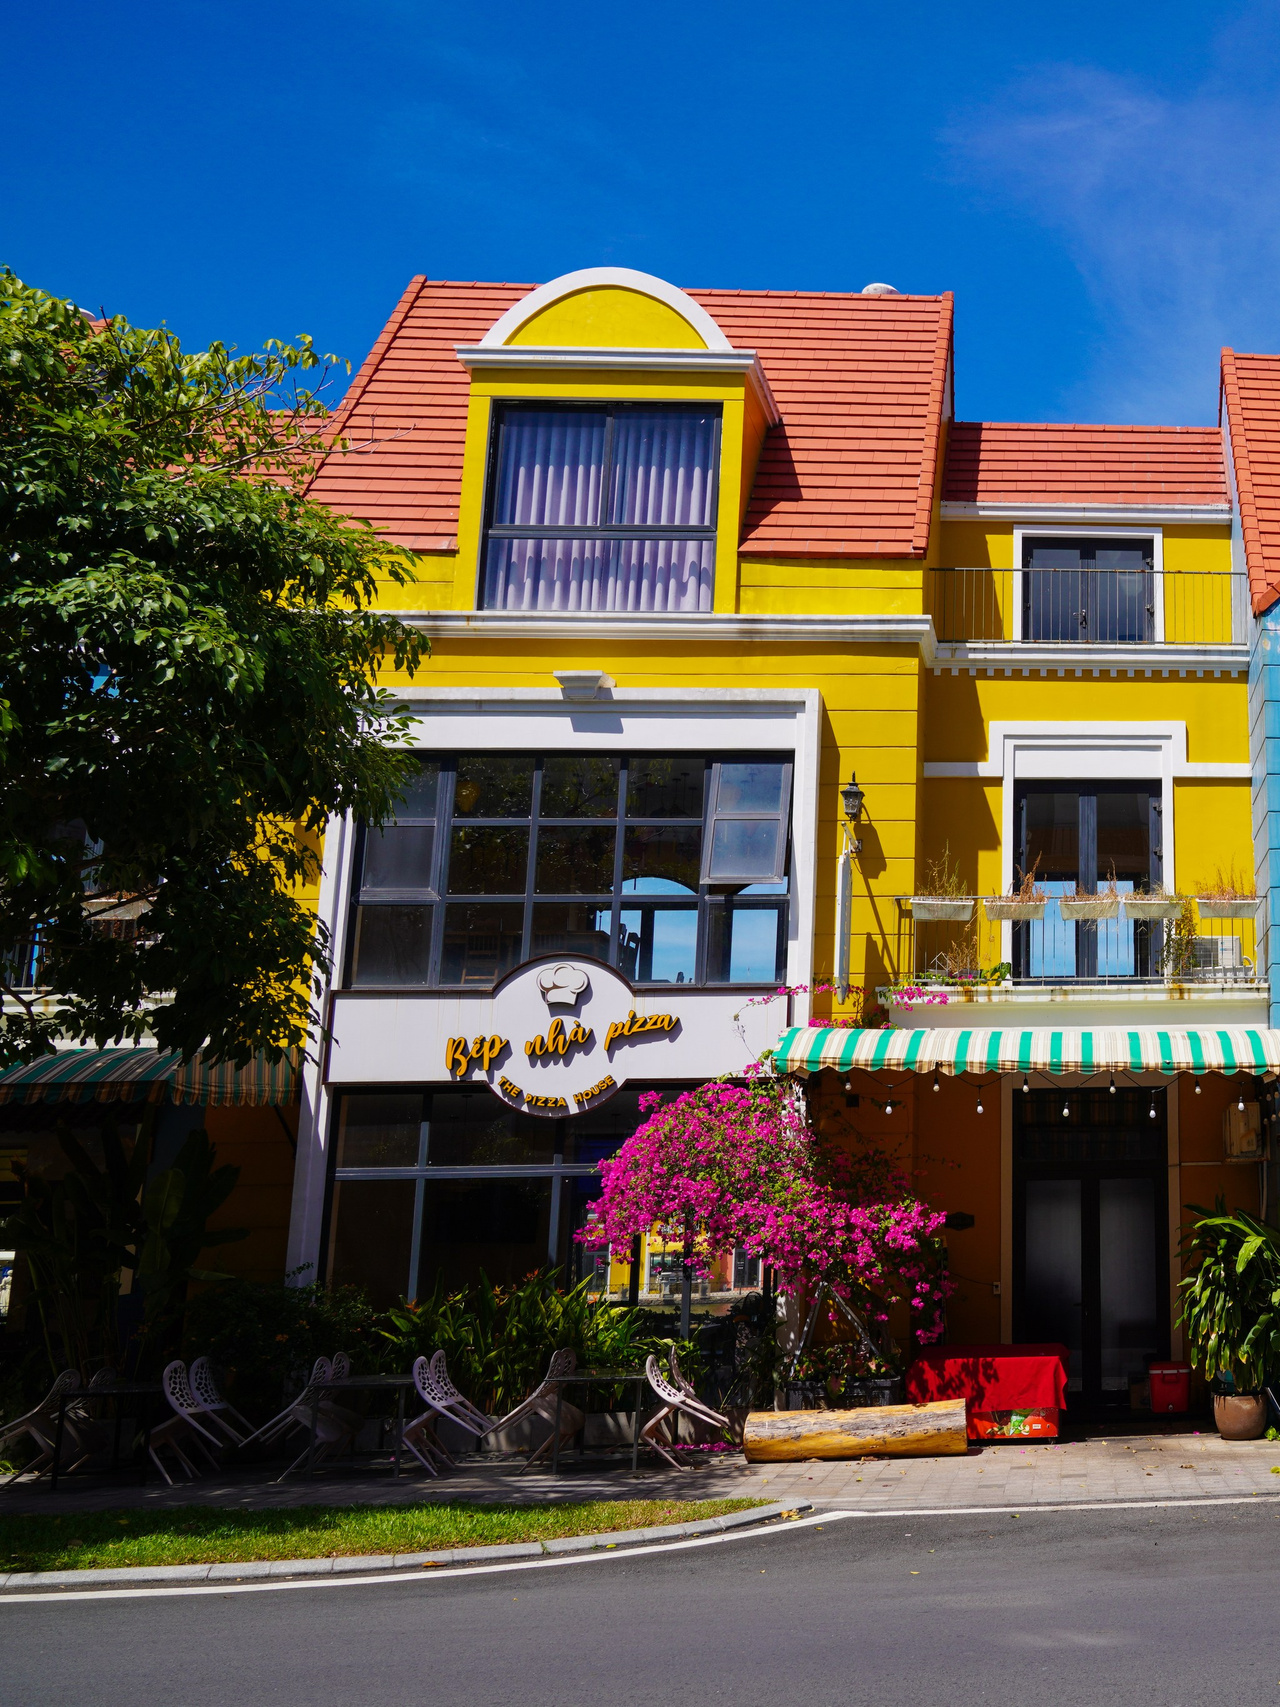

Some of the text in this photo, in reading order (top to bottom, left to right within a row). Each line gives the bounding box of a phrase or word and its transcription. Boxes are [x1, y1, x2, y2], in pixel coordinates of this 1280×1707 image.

[445, 1009, 680, 1077] Bếp nhà pizza
[496, 1074, 616, 1108] THE PIZZA HOUSE
